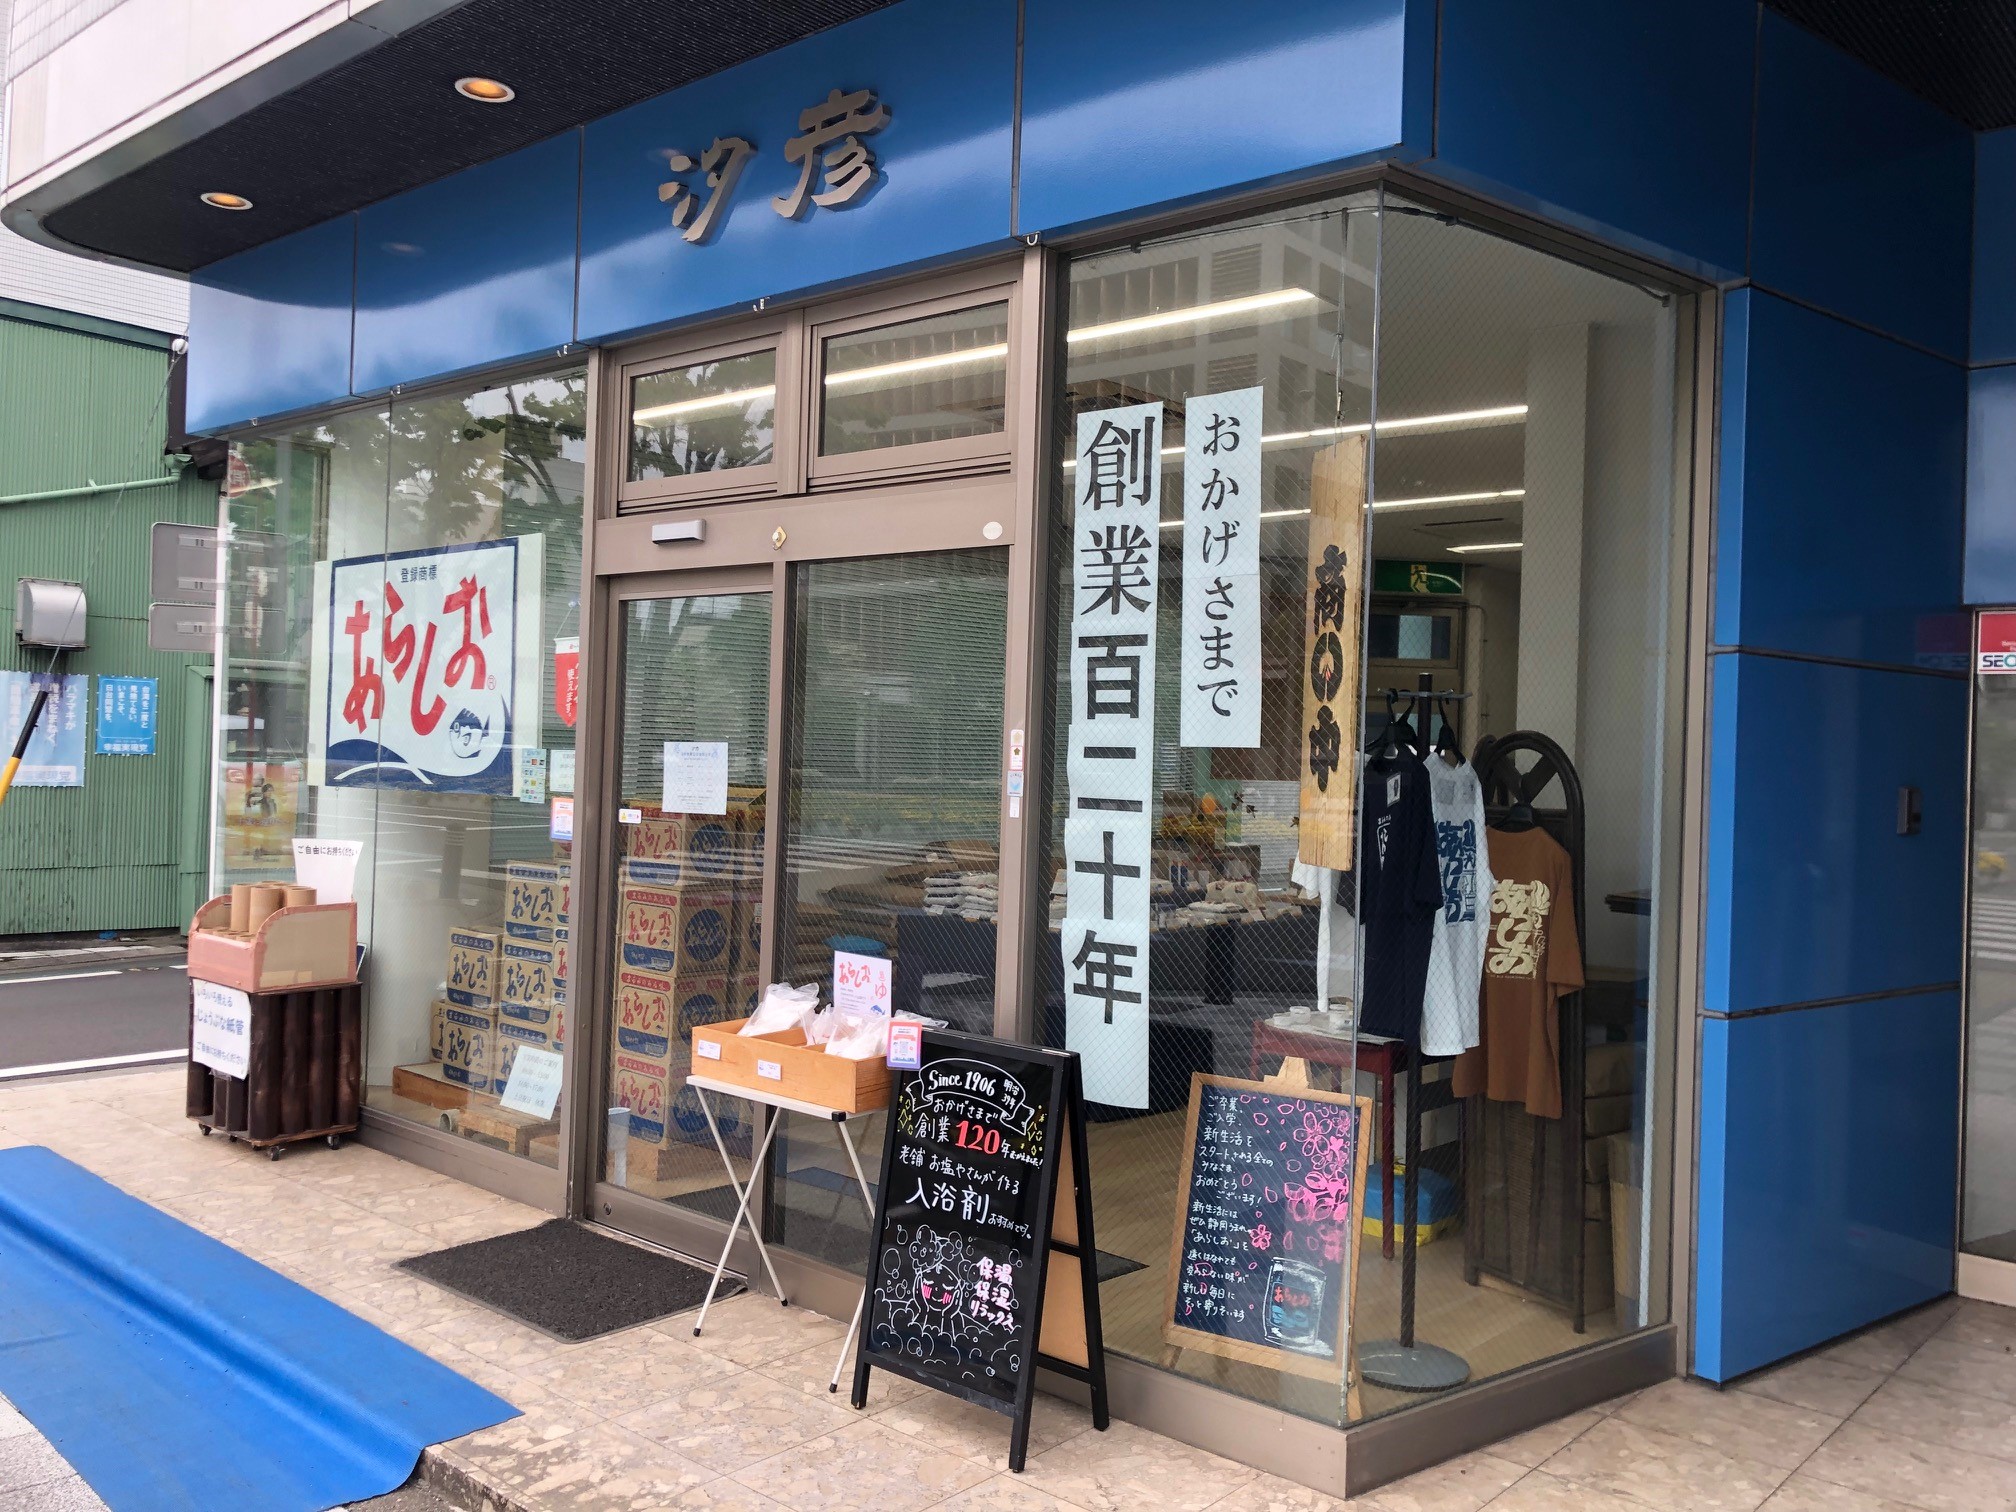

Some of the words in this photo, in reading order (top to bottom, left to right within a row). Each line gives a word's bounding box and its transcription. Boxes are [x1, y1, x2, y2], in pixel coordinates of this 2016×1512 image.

[658, 89, 892, 246] 汐彦
[401, 564, 437, 583] 登録商標
[1197, 413, 1240, 717] おかげさまで
[343, 574, 493, 736] あらしお
[1072, 416, 1156, 1024] 創業百二十年
[512, 883, 554, 921] あらしお
[628, 908, 671, 945] あらしお
[452, 951, 488, 989] あらしお
[506, 963, 546, 1001] あらしお
[839, 961, 871, 988] あらしお
[623, 992, 666, 1030] あらしお
[448, 1028, 484, 1066] あらしお
[928, 1070, 963, 1091] Since
[964, 1071, 997, 1097] 1906
[1003, 1079, 1020, 1096] 明治
[933, 1098, 998, 1123] おかげさまで
[1204, 1126, 1253, 1147] 新生活を
[1196, 1175, 1238, 1190] おめでとう
[1192, 1200, 1238, 1219] 新生活には
[970, 1300, 1015, 1330] リラックス
